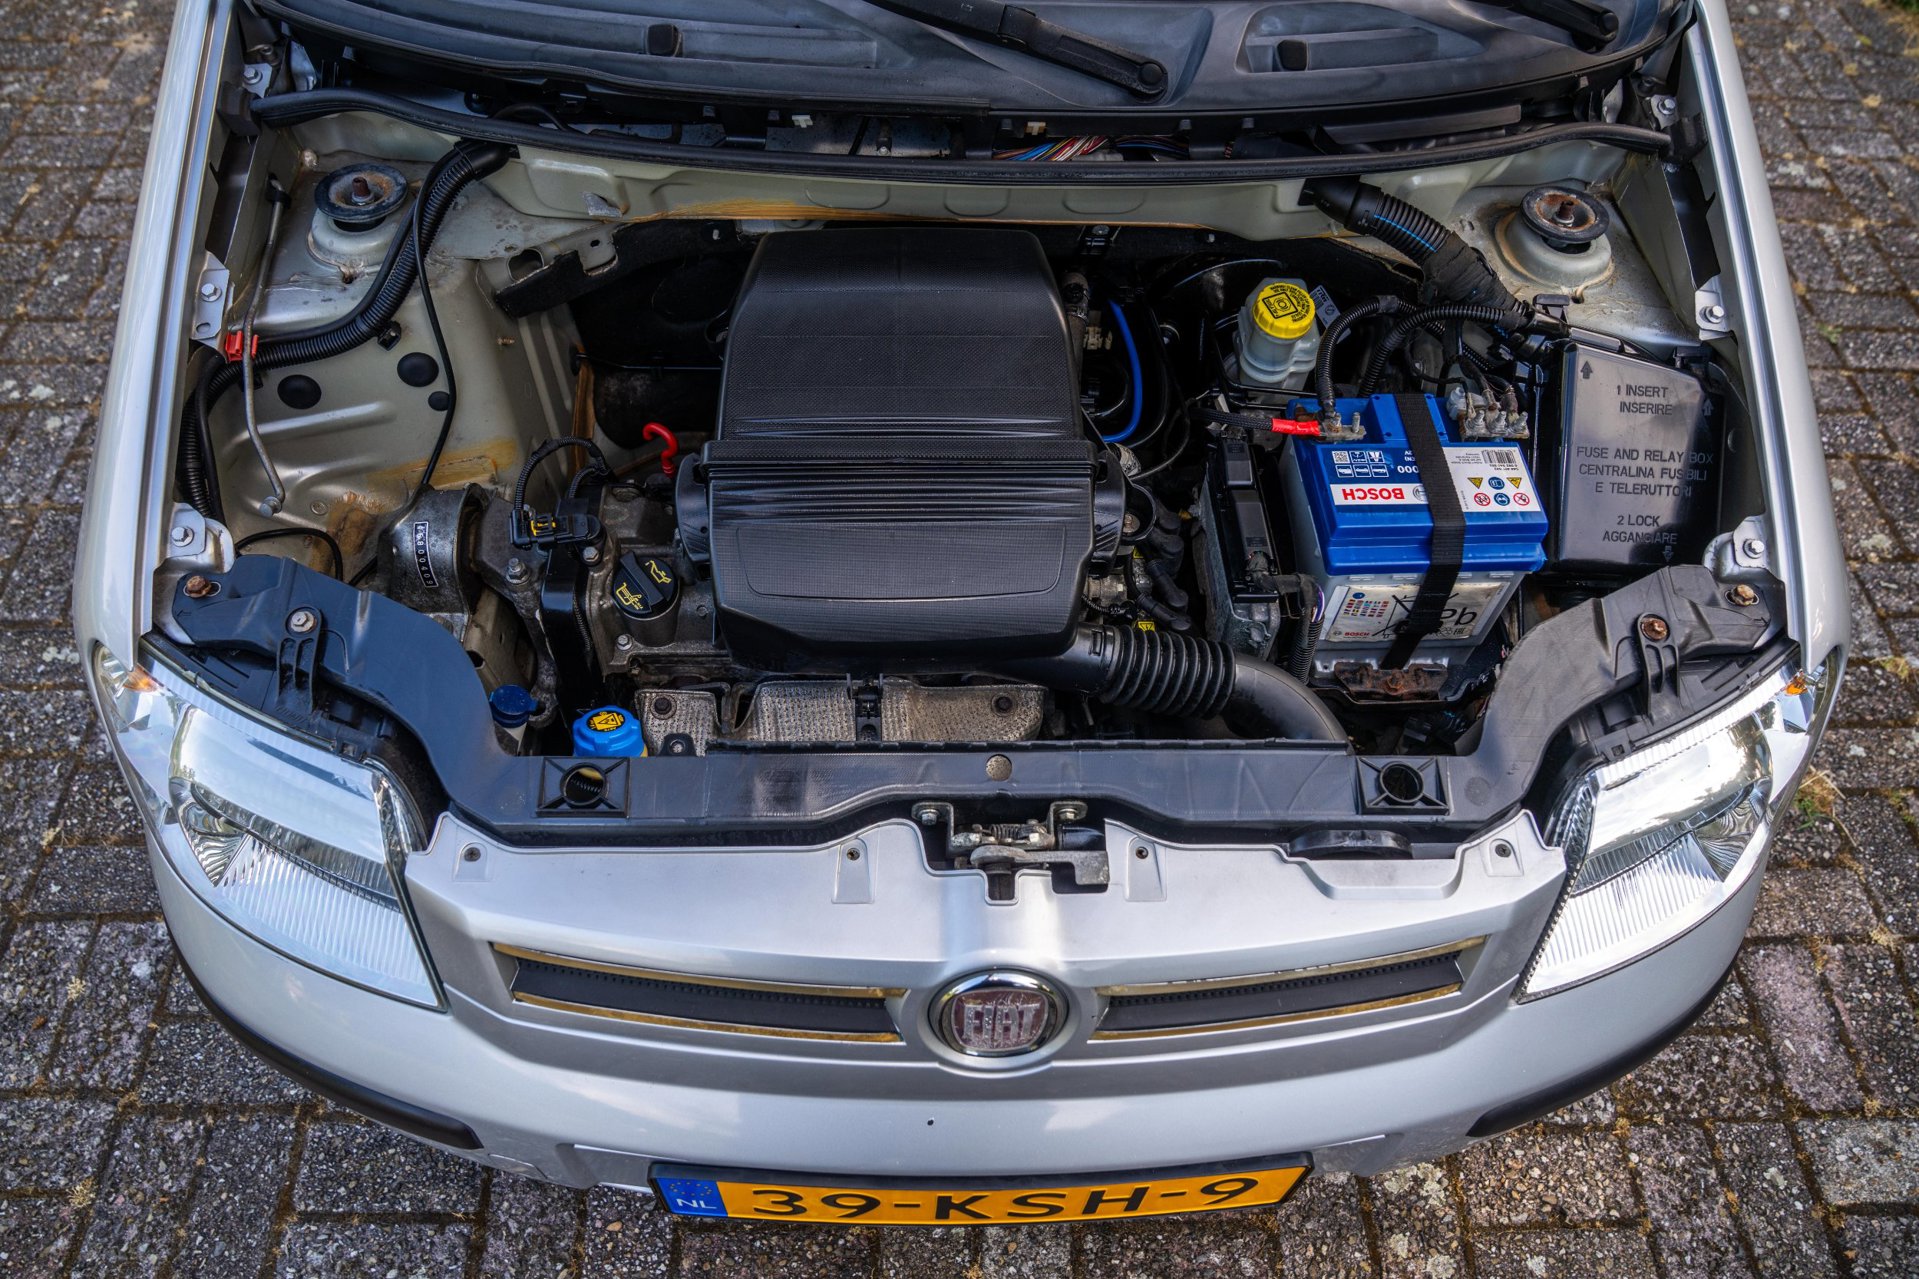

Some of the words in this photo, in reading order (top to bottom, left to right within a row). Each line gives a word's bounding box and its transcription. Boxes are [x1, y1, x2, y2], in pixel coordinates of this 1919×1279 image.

[1617, 385, 1621, 396] 1
[1626, 384, 1669, 398] INSERT
[1619, 401, 1673, 416] INSERIRE
[1576, 446, 1609, 459] FUSE
[1614, 448, 1639, 460] AND
[1644, 450, 1685, 463] RELAY
[1689, 452, 1713, 464] BOX
[1578, 463, 1655, 479] CENTRALINA
[1660, 467, 1707, 481] FUSBILI
[1341, 487, 1405, 501] BOSCH
[1595, 482, 1604, 493] E
[1609, 482, 1692, 497] TELERUTTORI
[1617, 515, 1624, 526] 2
[1627, 514, 1661, 527] LOCK
[1602, 530, 1678, 545] AGGANCIARE
[963, 1003, 1041, 1041] FIAT
[676, 1197, 718, 1211] NL
[752, 1177, 1259, 1220] 39-KSH-9
